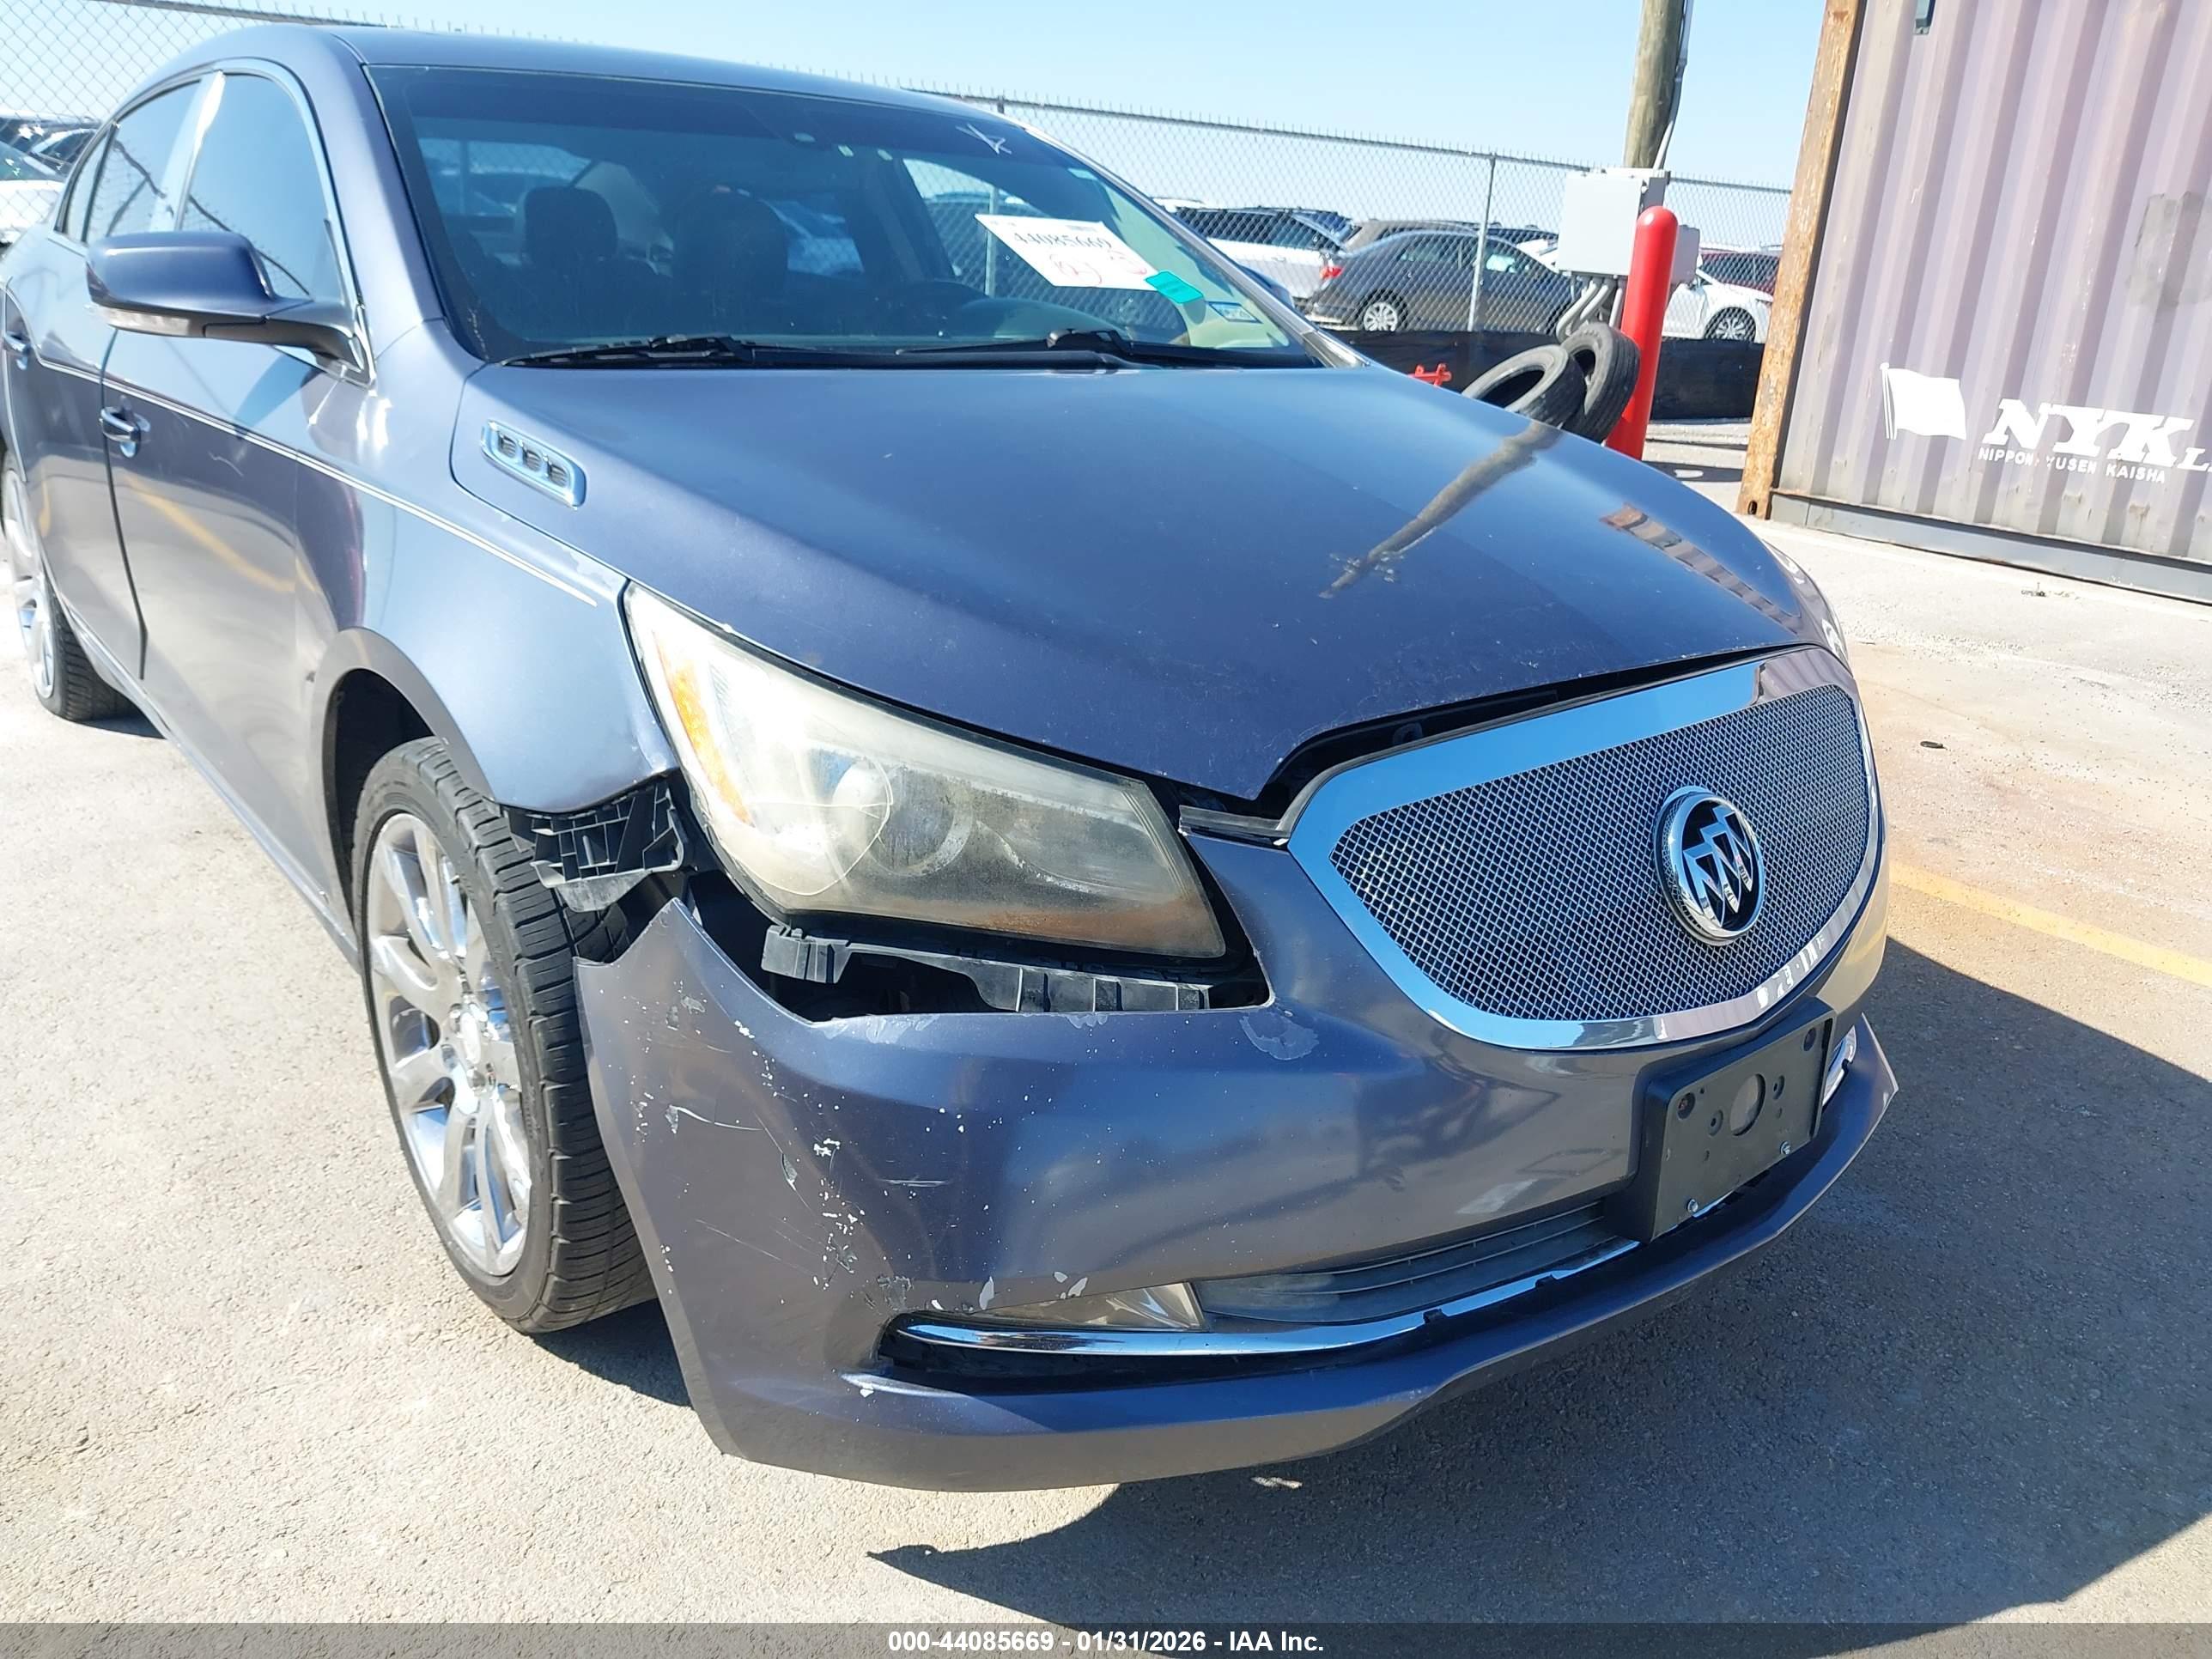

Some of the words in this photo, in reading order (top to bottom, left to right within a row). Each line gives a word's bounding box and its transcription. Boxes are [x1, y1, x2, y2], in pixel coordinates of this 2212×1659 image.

[1982, 398, 2195, 468] NYK
[2177, 447, 2212, 473] L
[1978, 447, 2040, 466] NIPPON
[2045, 455, 2097, 474] YUSEN
[2106, 463, 2165, 483] KAISHA
